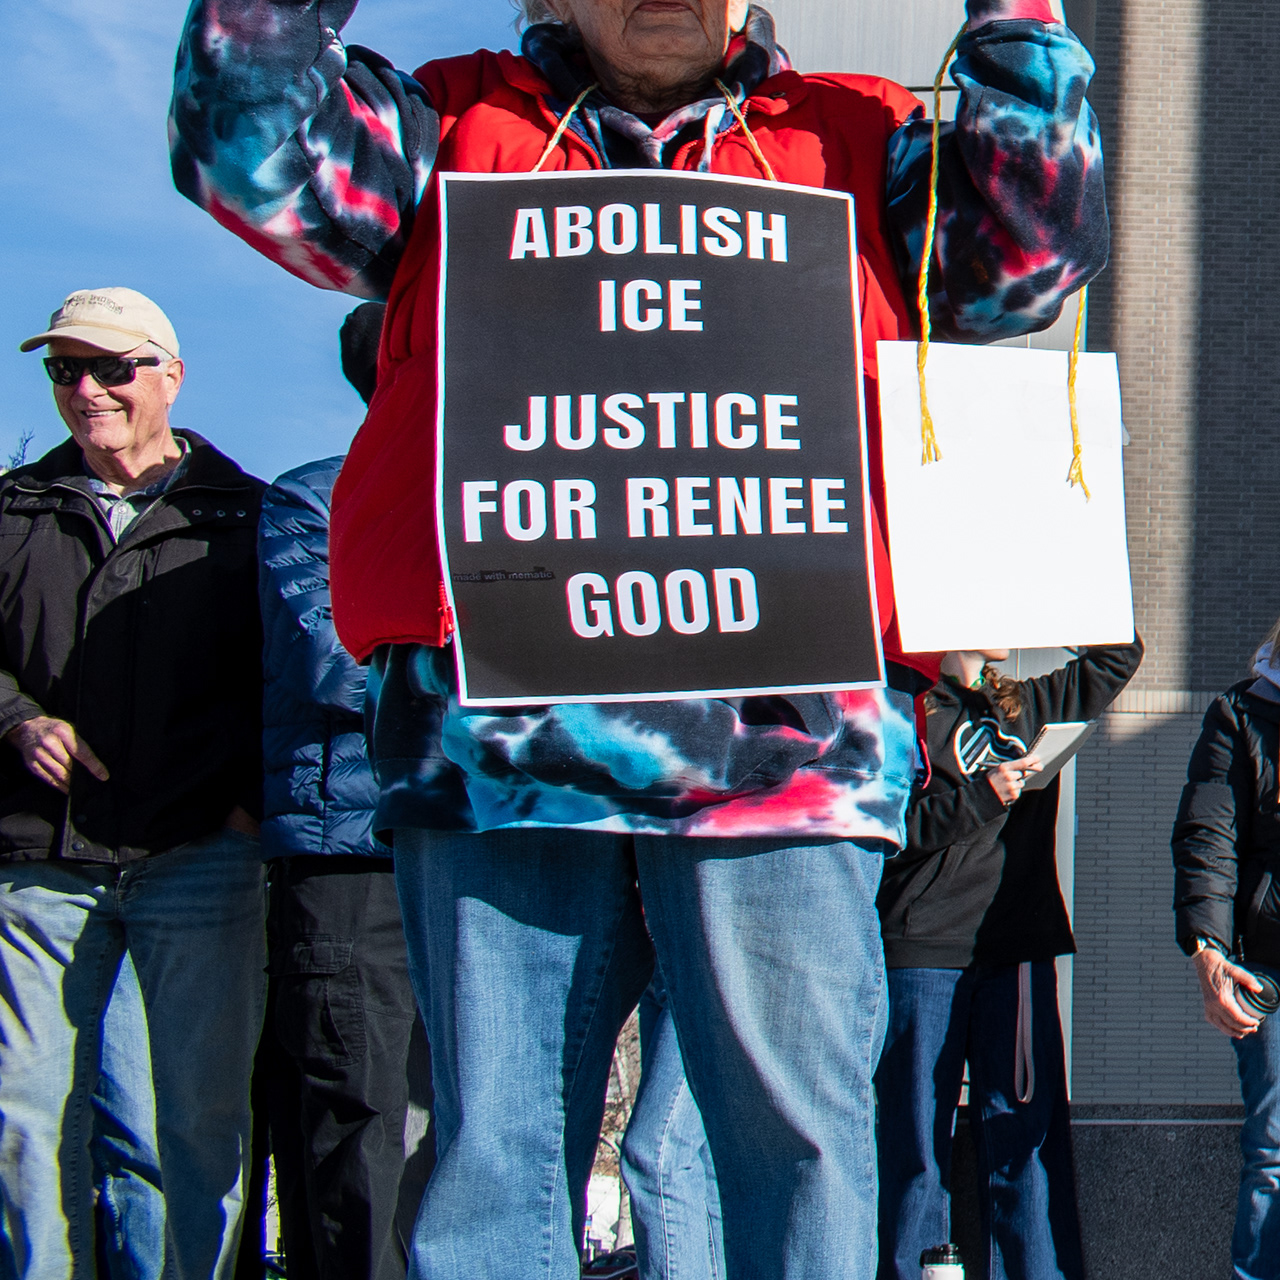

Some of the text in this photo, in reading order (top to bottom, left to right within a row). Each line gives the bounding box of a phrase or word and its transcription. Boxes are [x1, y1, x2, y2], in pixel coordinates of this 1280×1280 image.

[510, 203, 788, 263] ABOLISH
[600, 279, 703, 332] ICE
[503, 392, 801, 451] JUSTICE
[462, 477, 849, 543] FOR RENEE
[484, 571, 506, 581] with
[566, 568, 760, 639] GOOD
